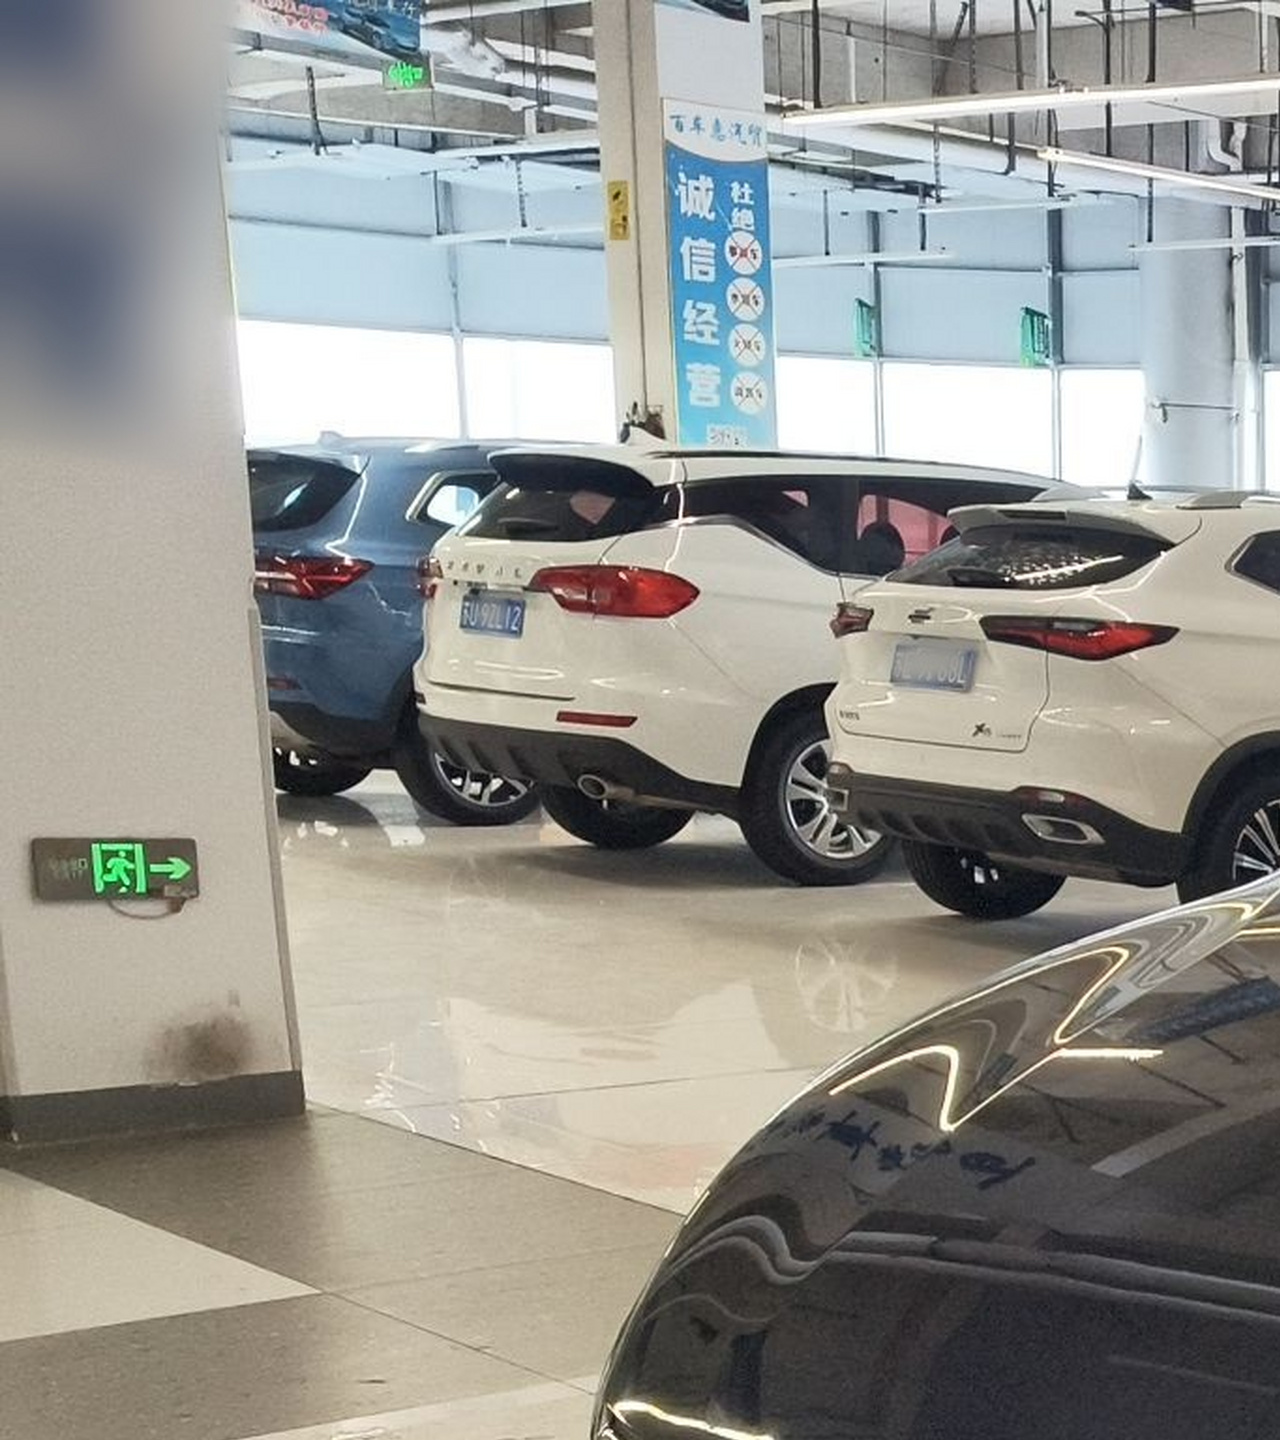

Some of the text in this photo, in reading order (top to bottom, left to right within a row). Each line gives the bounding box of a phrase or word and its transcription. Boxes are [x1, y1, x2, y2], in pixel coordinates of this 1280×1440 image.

[730, 181, 755, 232] 杜绝
[675, 170, 721, 408] 诚信经营
